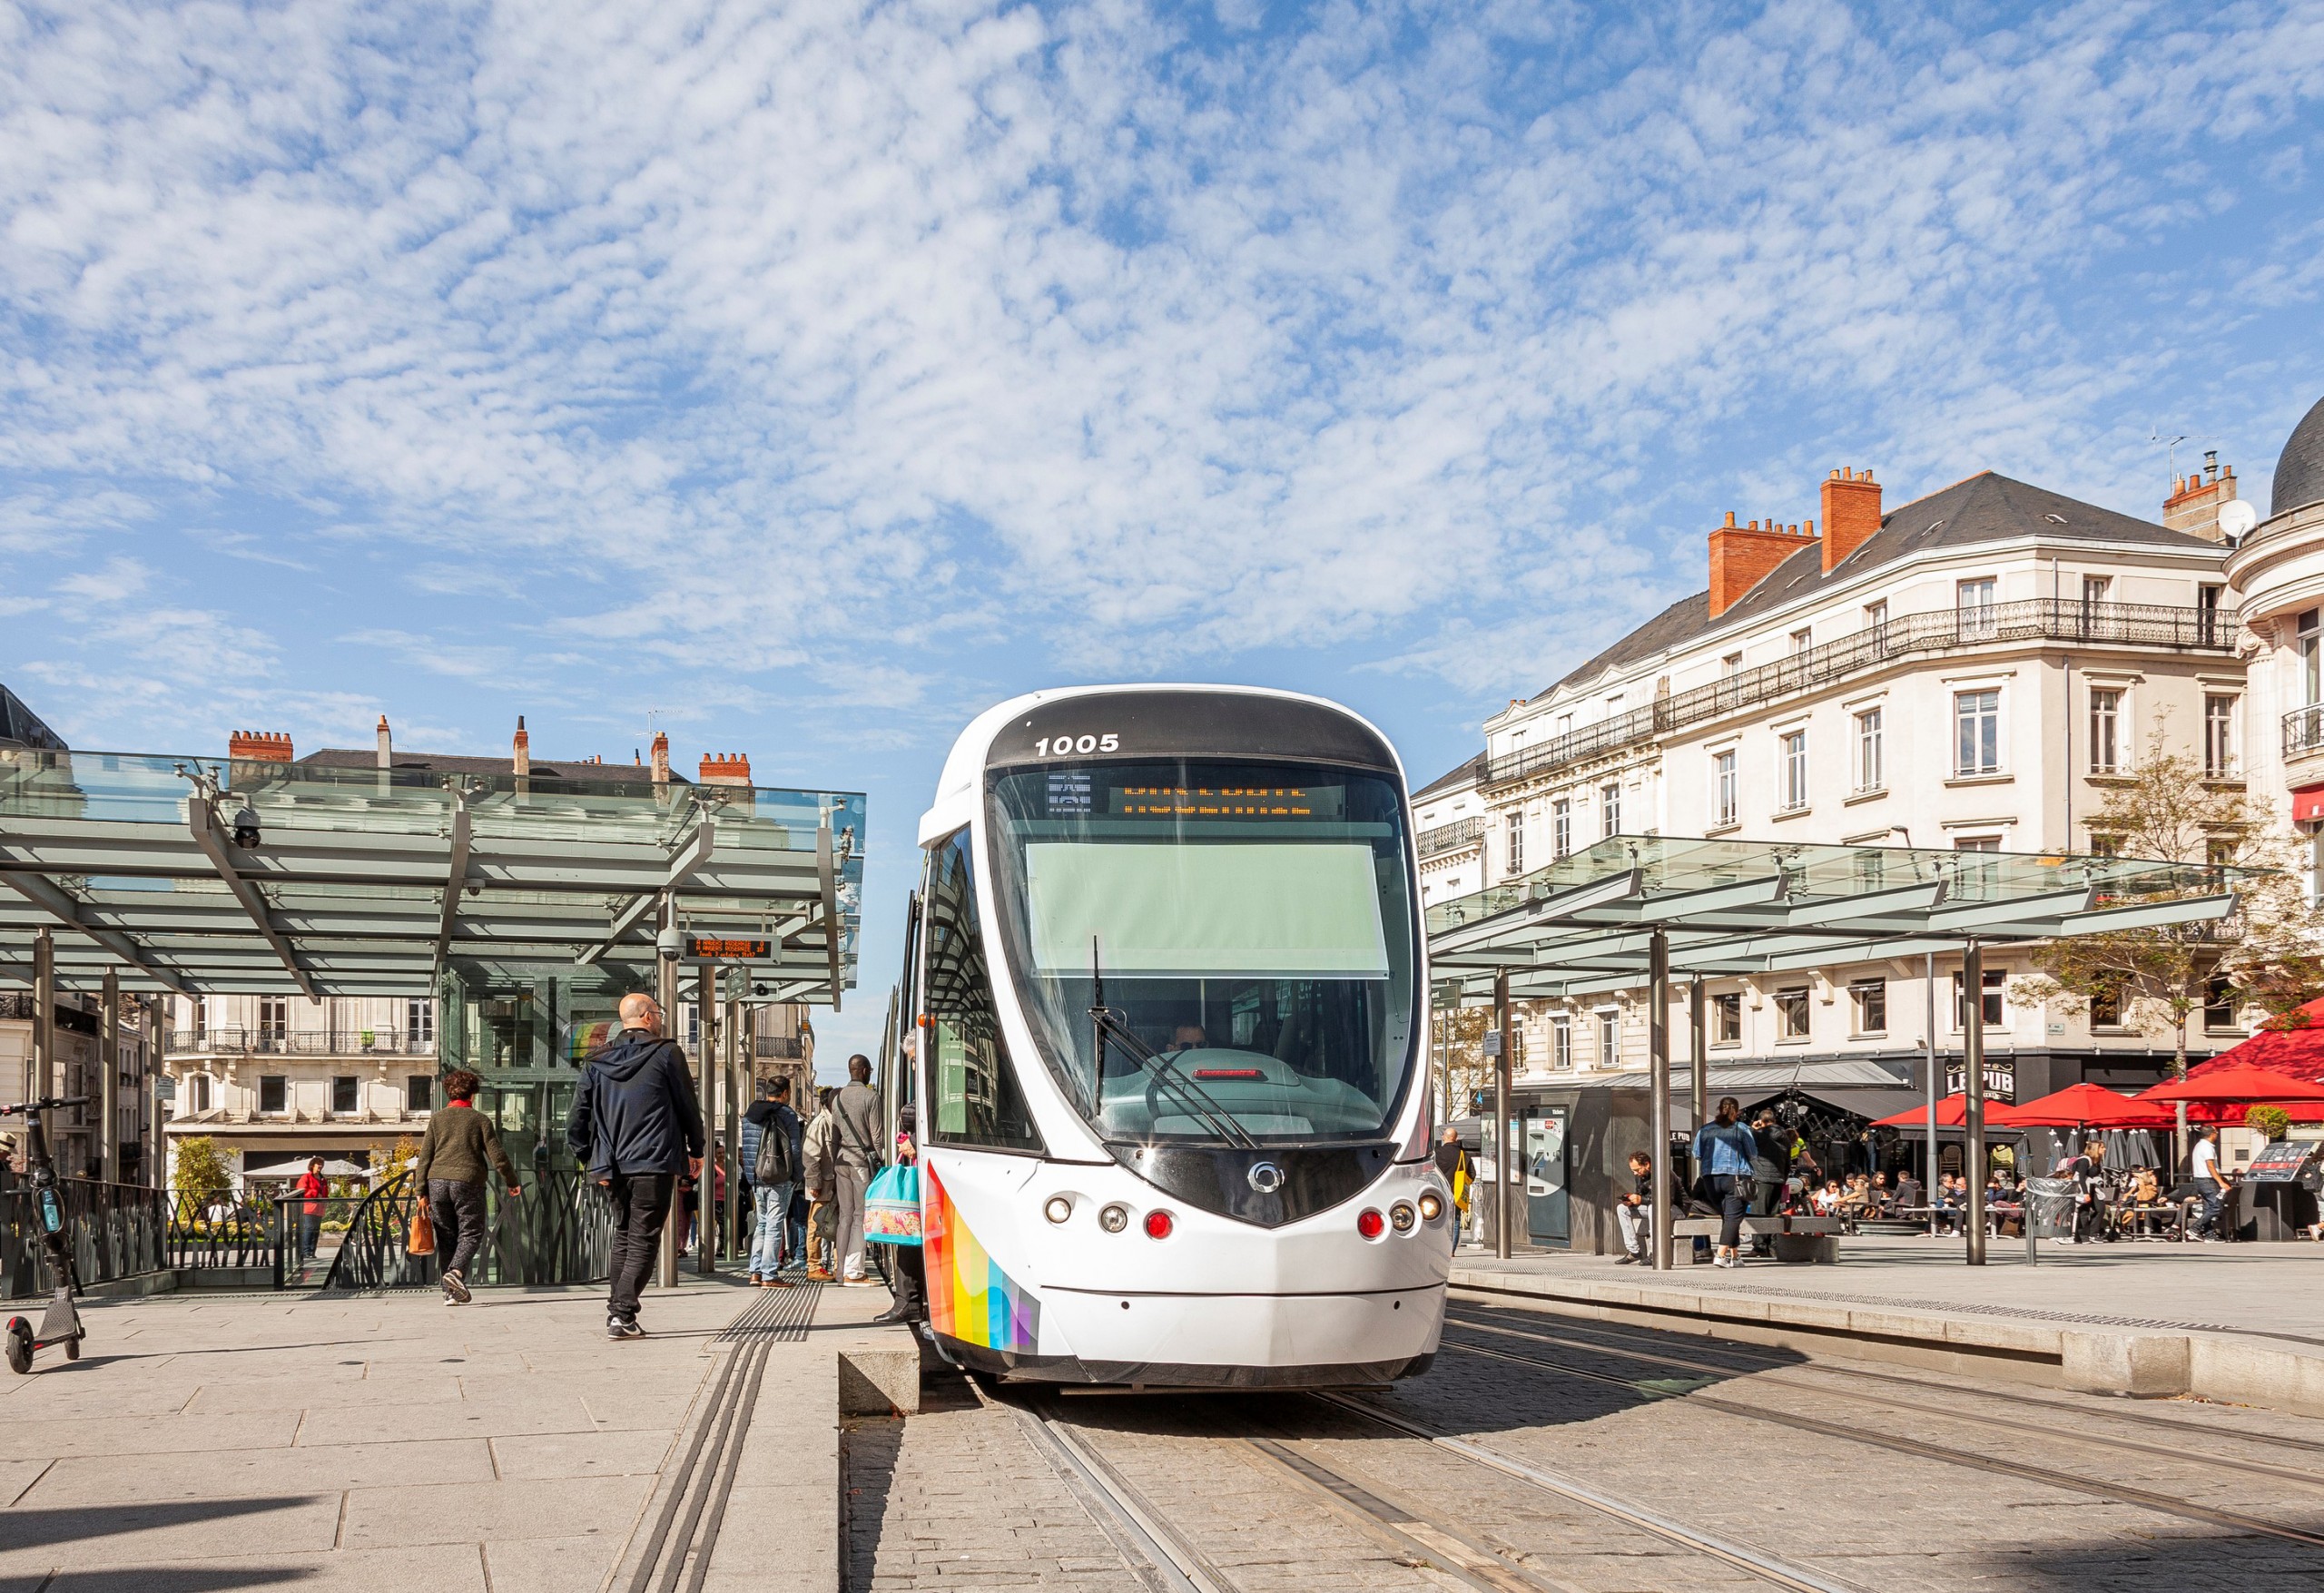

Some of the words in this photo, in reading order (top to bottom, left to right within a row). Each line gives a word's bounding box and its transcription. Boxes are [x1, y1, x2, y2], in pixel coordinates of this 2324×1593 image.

[1035, 733, 1119, 757] 1005
[1946, 1073, 1965, 1094] LE
[1678, 1132, 1690, 1141] PUB
